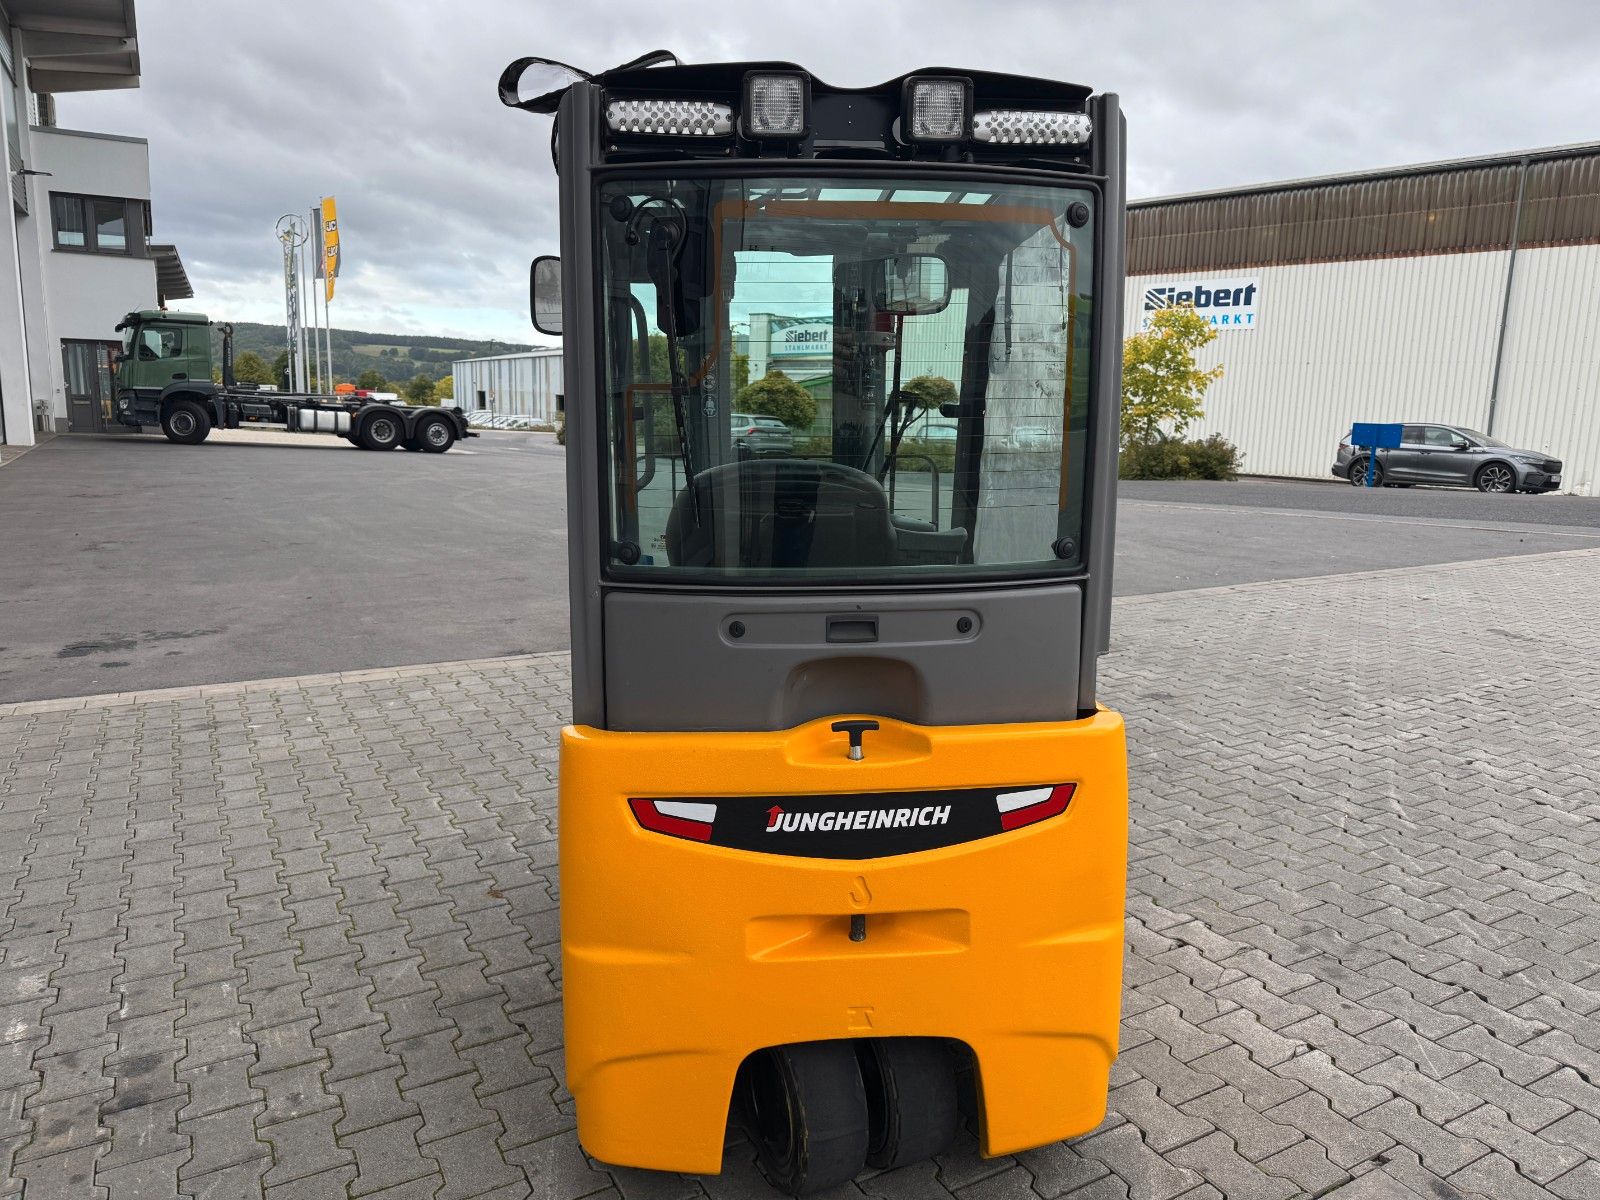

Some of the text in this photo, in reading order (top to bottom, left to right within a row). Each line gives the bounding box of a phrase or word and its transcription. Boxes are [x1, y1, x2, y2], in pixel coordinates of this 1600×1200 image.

[1144, 283, 1256, 311] Siebert
[785, 329, 828, 342] Siebert
[765, 805, 951, 833] JUNGHEINRICH
